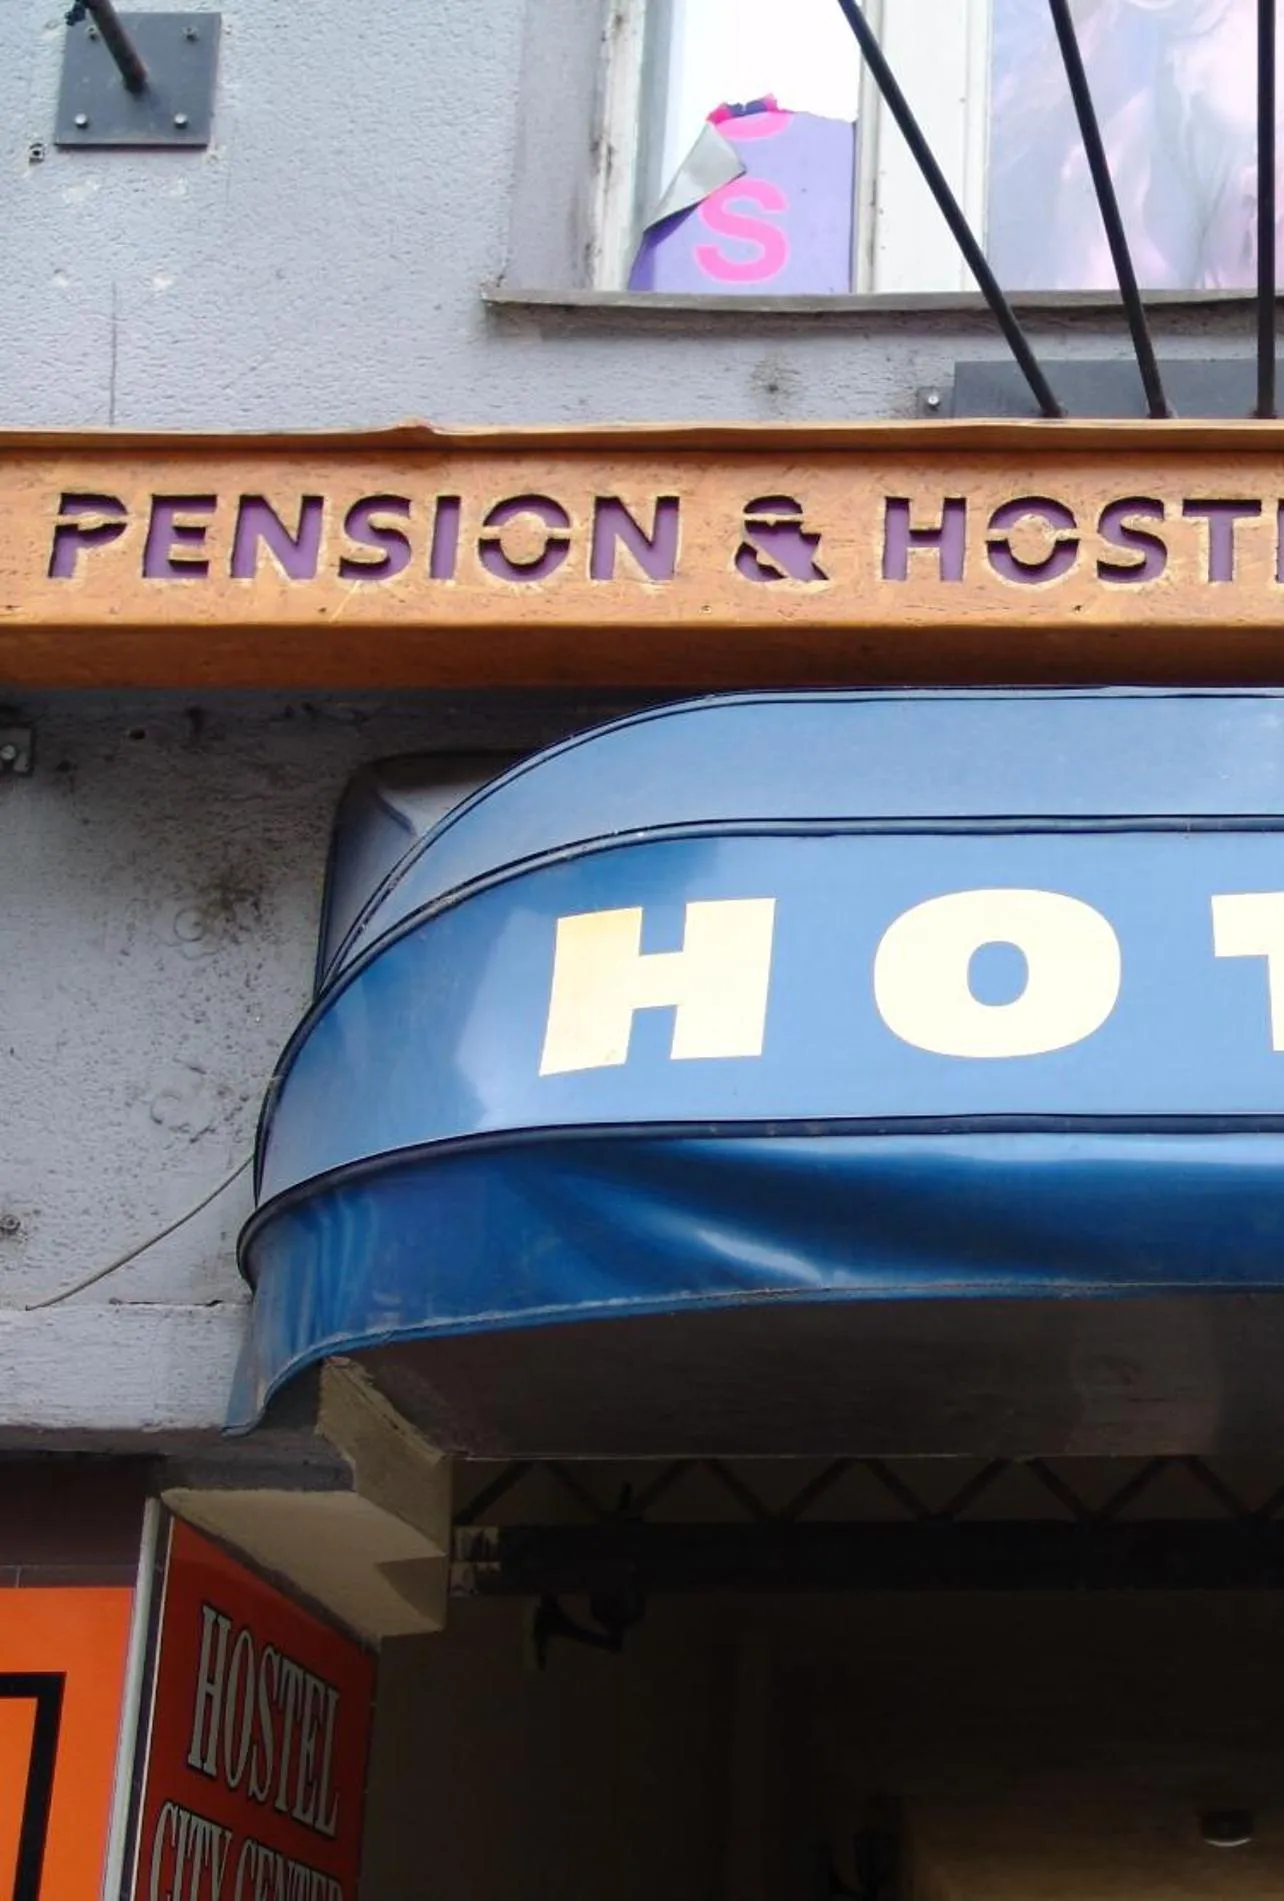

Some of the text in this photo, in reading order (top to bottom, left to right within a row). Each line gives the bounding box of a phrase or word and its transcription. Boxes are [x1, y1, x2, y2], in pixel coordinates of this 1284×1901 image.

[48, 491, 682, 581] PENSION
[734, 494, 831, 581] &
[187, 1604, 341, 1838] HOSTEL
